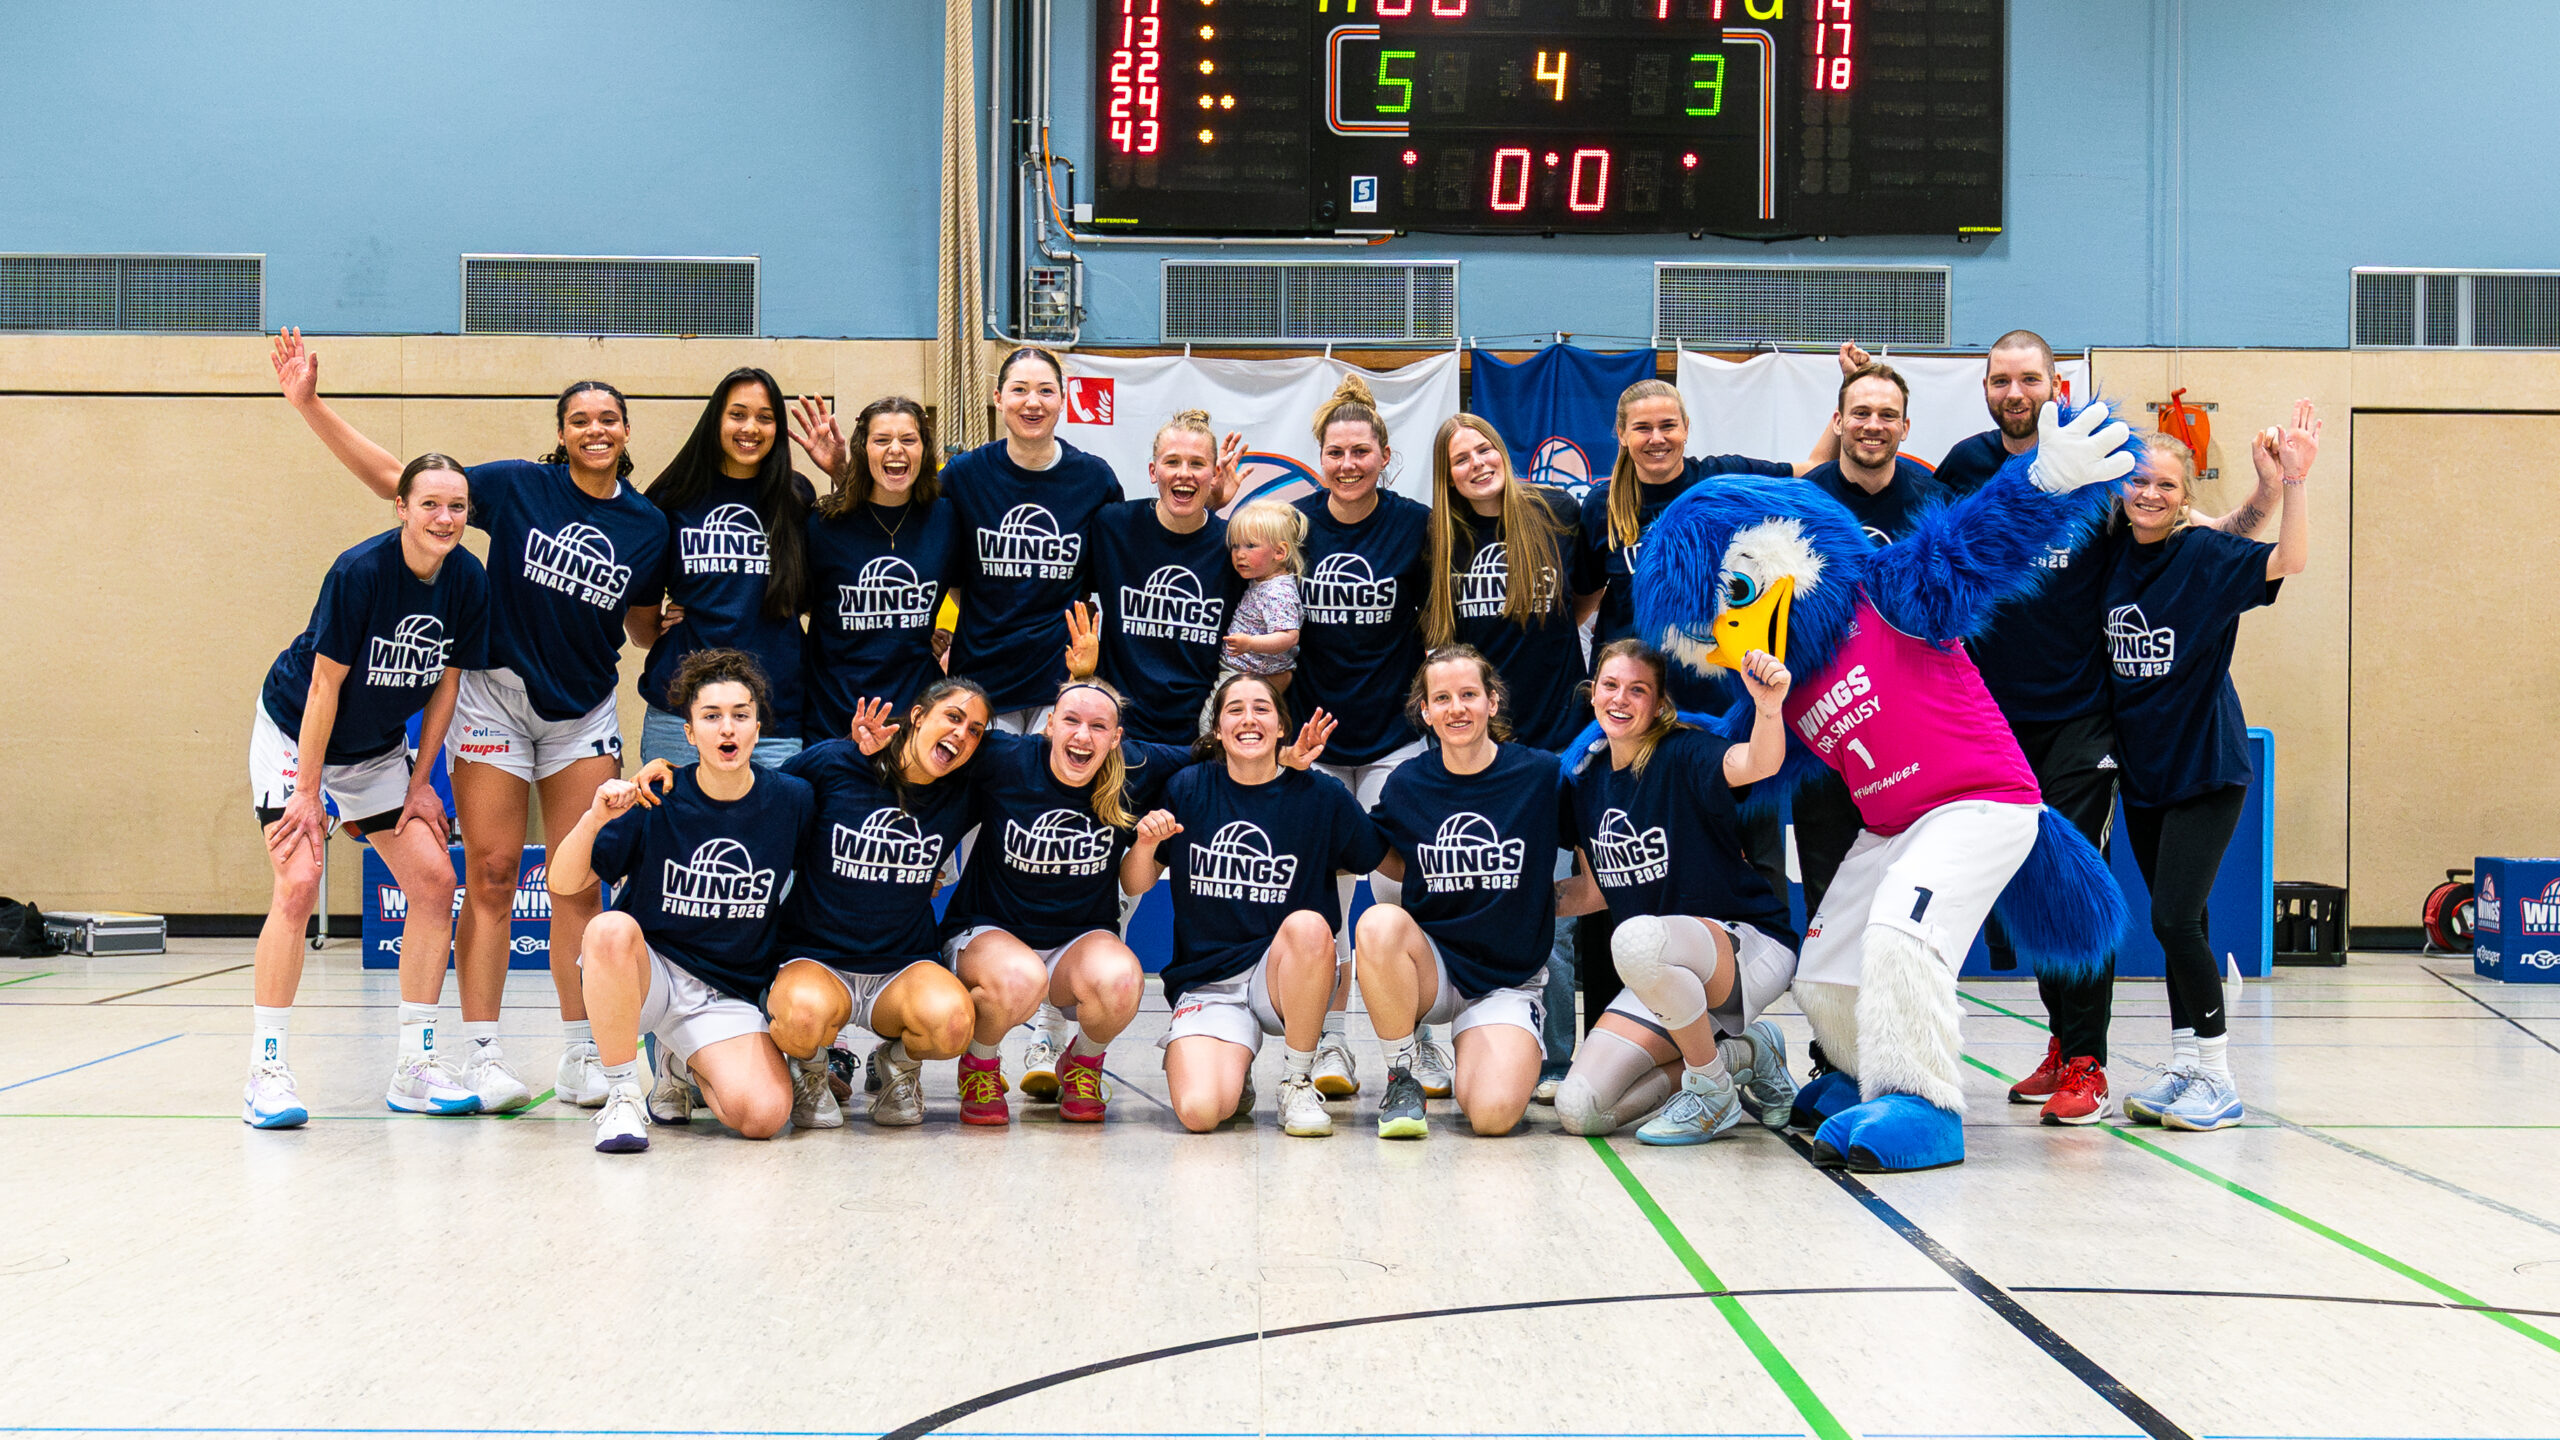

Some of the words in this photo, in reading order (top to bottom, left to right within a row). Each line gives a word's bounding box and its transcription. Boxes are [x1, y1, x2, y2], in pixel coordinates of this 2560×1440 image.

[1123, 16, 1159, 48] 13
[1815, 23, 1852, 54] 17
[1111, 50, 1159, 83] 22
[1376, 51, 1416, 113] 5
[1536, 52, 1567, 101] 4
[1815, 58, 1852, 89] 18
[1686, 54, 1725, 116] 3
[1111, 86, 1159, 118] 24
[1111, 121, 1159, 152] 43
[681, 528, 770, 560] WING
[977, 527, 1081, 566] WINGS
[524, 528, 632, 600] WINGS
[684, 559, 738, 574] FINAL4
[744, 560, 771, 575] 202
[982, 562, 1032, 578] FINAL4
[1039, 564, 1075, 580] 2026
[523, 563, 577, 596] FINAL4
[580, 587, 617, 611] 2026
[838, 581, 938, 616] WINGS
[1301, 577, 1397, 610] WINGS
[842, 614, 893, 630] FINAL4
[900, 612, 930, 629] 2026
[1120, 586, 1224, 631] WINGS
[1355, 609, 1393, 625] 2026
[1122, 619, 1174, 639] FINAL4
[1180, 627, 1217, 645] 2026
[366, 671, 417, 688] FINAL4
[1797, 664, 1872, 742] WINGS
[472, 726, 489, 737] evl
[460, 740, 510, 756] wupsi
[1847, 737, 1876, 770] 1
[832, 823, 943, 869] WINGS
[1004, 820, 1114, 864] WINGS
[1417, 838, 1524, 878] WINGS
[1590, 827, 1668, 872] WINGS
[832, 859, 889, 882] FINAL4
[896, 869, 933, 884] 2026
[1004, 854, 1060, 875] FINAL4
[1069, 859, 1108, 876] 2026
[1190, 843, 1298, 889] WINGS
[662, 859, 775, 904] WINGS
[1190, 880, 1243, 900] FINAL4
[1249, 887, 1287, 904] 2026
[1481, 875, 1520, 890] 2026
[662, 897, 720, 919] FINAL4
[727, 904, 766, 919] 2026
[1910, 886, 1933, 924] 1
